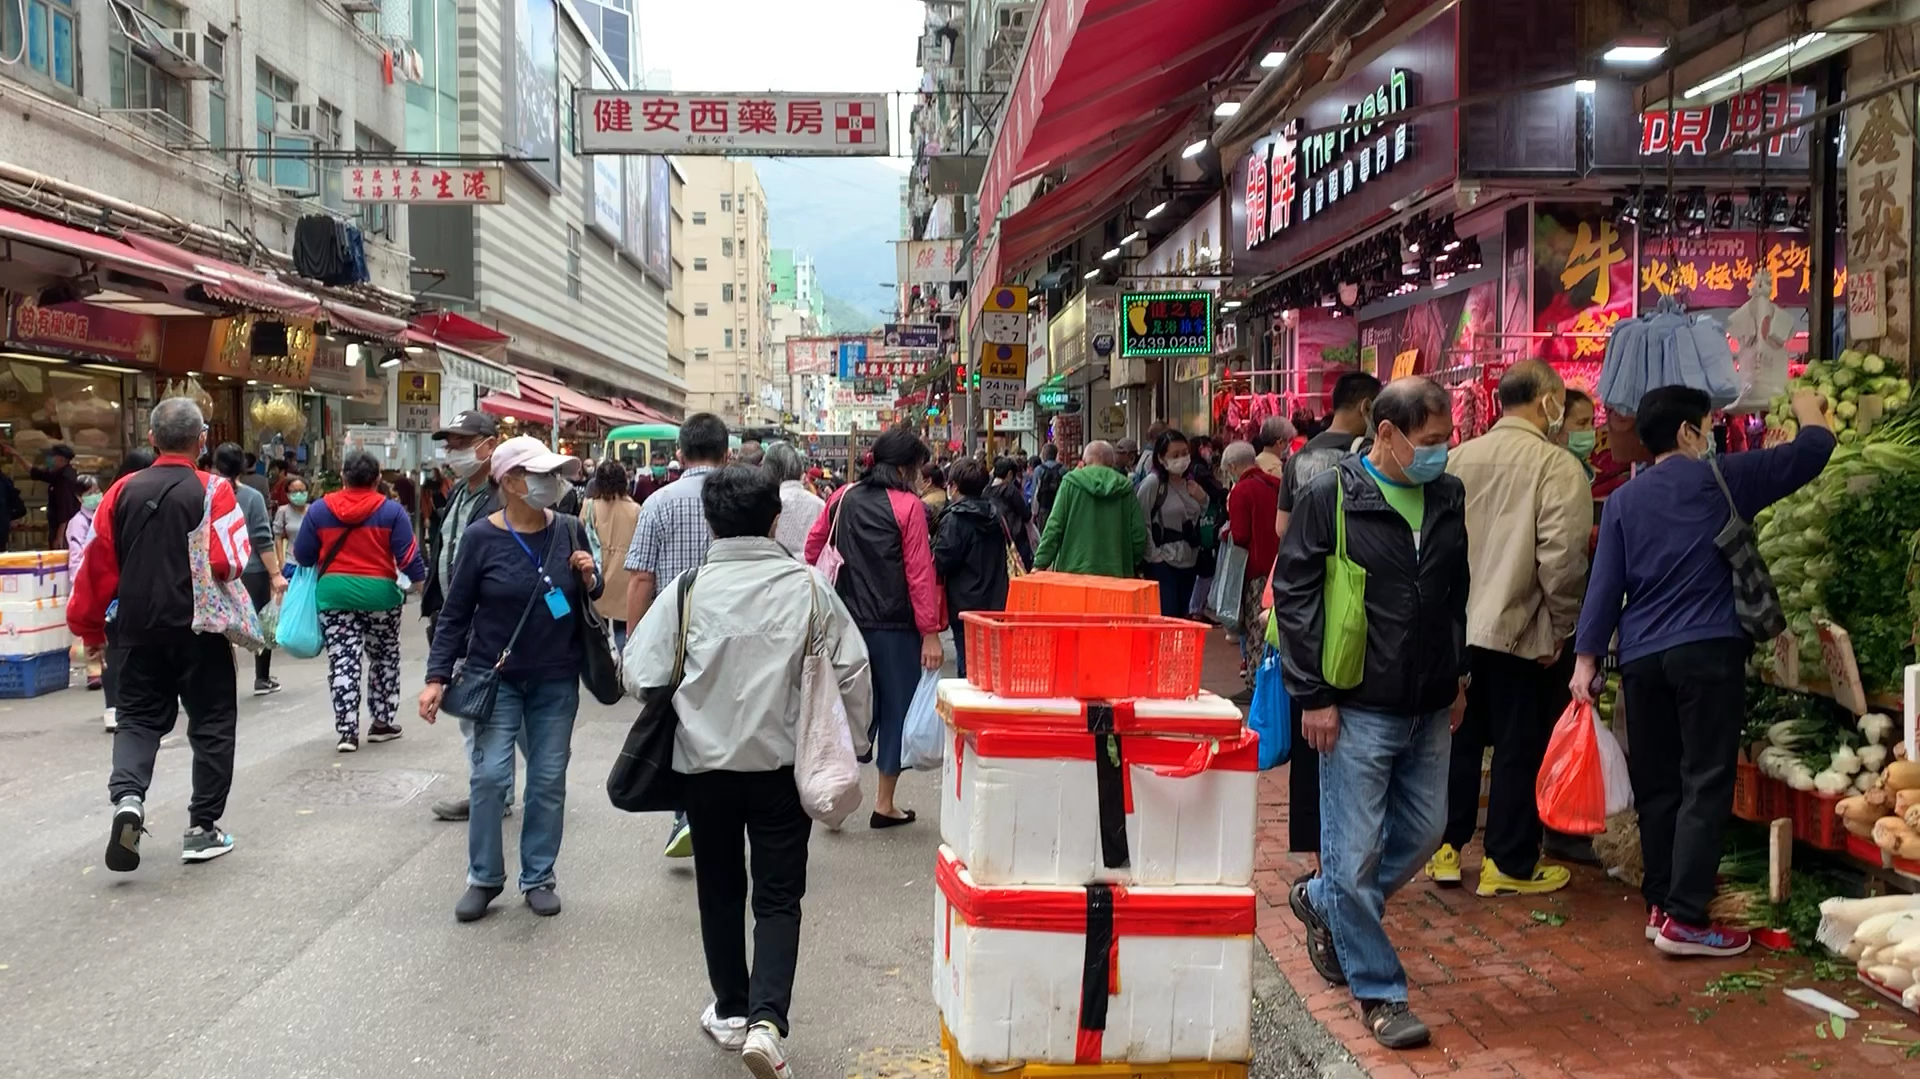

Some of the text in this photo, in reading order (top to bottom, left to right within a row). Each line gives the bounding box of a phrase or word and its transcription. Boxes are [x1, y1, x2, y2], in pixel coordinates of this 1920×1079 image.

[592, 97, 824, 135] 健安西藥房
[1011, 315, 1020, 326] 7
[1011, 331, 1019, 342] 7
[1128, 337, 1166, 351] 2439
[1169, 335, 1207, 350] 0289
[985, 380, 1020, 392] 24 hrs
[989, 392, 1017, 407] 全日
[409, 406, 429, 416] End
